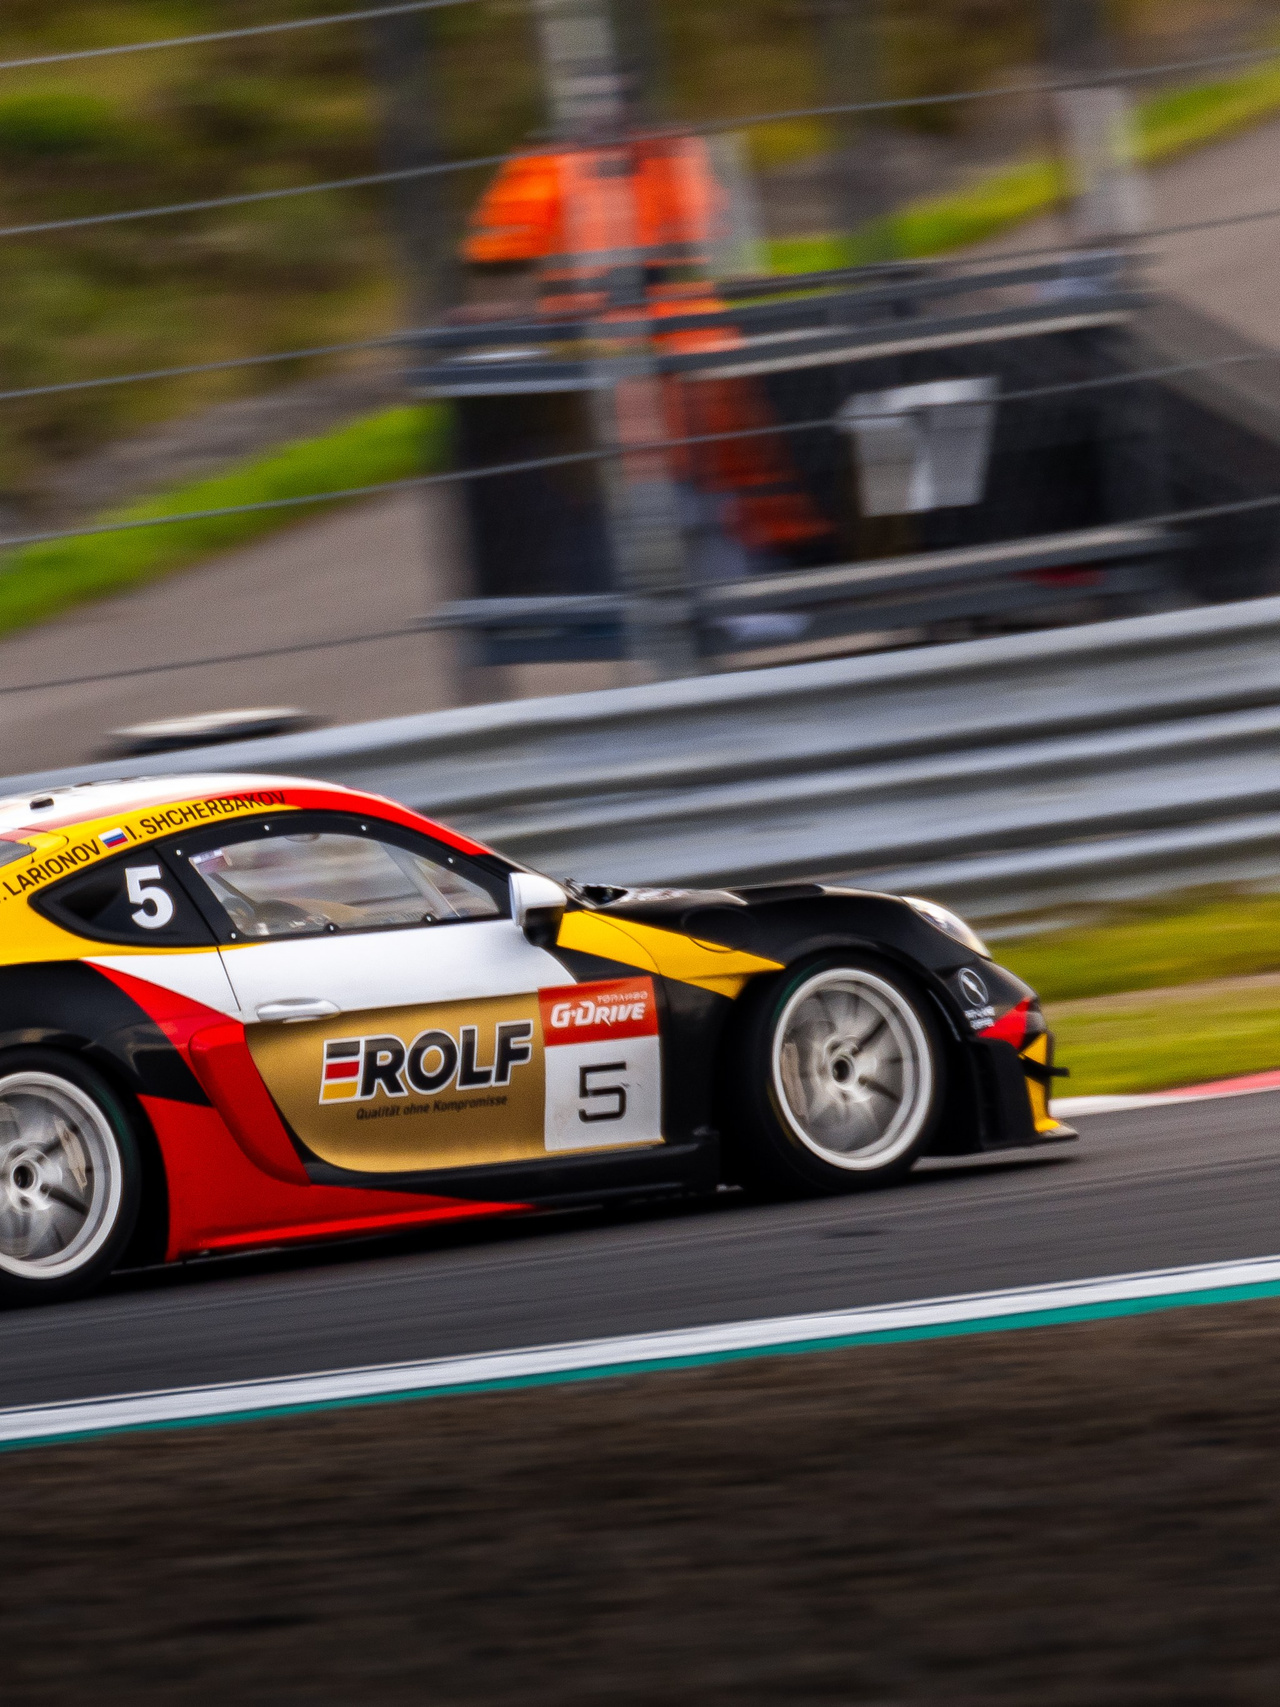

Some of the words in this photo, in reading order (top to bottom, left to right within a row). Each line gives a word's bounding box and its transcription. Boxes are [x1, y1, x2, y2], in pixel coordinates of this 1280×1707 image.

[124, 824, 140, 842] I.
[146, 790, 286, 835] SHCHERBAKOV
[6, 839, 100, 896] LARIONOV
[124, 864, 175, 929] 5
[359, 1018, 533, 1099] ROLF
[356, 1105, 400, 1120] Qualität
[403, 1102, 430, 1115] ohne
[433, 1095, 508, 1112] Kompromisse
[578, 1062, 626, 1124] 5
